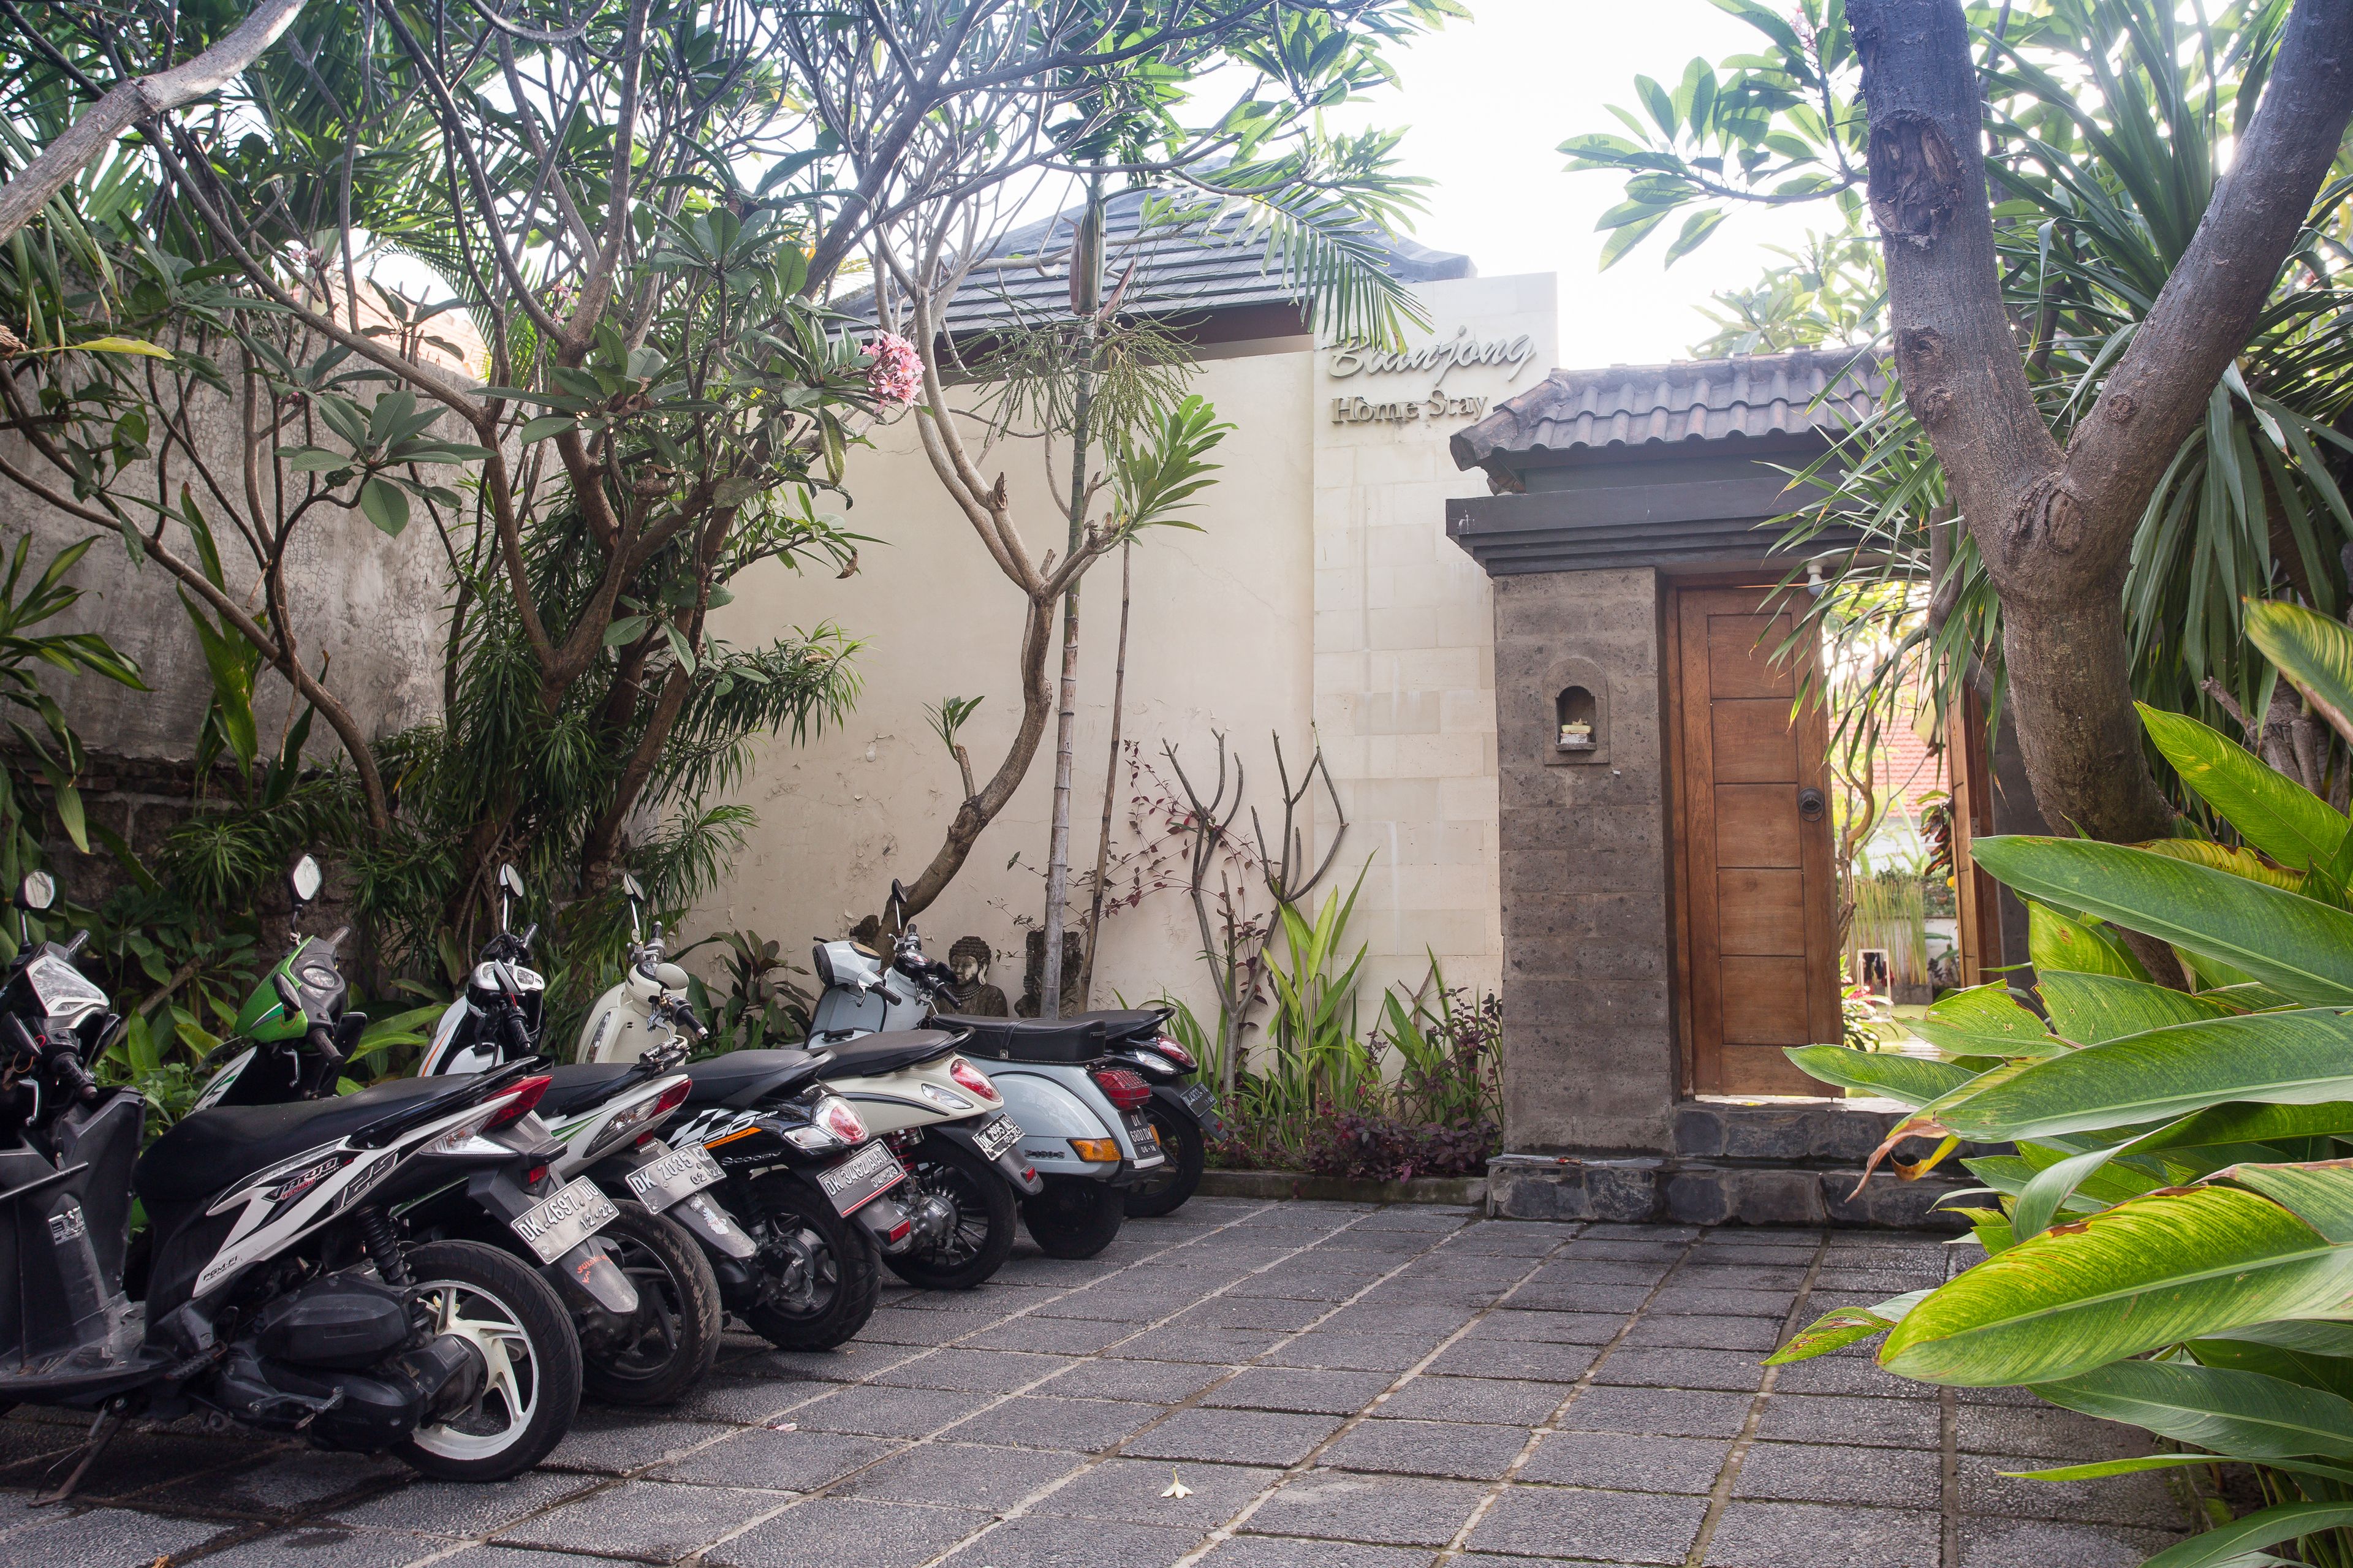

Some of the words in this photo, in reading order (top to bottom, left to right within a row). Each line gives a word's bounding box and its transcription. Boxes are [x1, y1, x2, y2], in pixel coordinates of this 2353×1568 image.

[1332, 396, 1419, 424] Home
[1428, 389, 1488, 421] Stay
[802, 1084, 820, 1094] HONDA
[1131, 1114, 1142, 1127] DK
[639, 1141, 659, 1154] HONDA
[978, 1131, 994, 1149] DK
[261, 1157, 339, 1203] VARIO
[280, 1178, 316, 1200] TECHNO
[332, 1147, 400, 1214] 125
[631, 1170, 658, 1194] DK
[657, 1152, 694, 1180] 2035
[824, 1175, 844, 1196] DK
[841, 1161, 870, 1185] 3482
[868, 1147, 890, 1170] AAT
[517, 1215, 545, 1242] DK
[544, 1192, 579, 1225] 4697
[577, 1180, 599, 1201] DU
